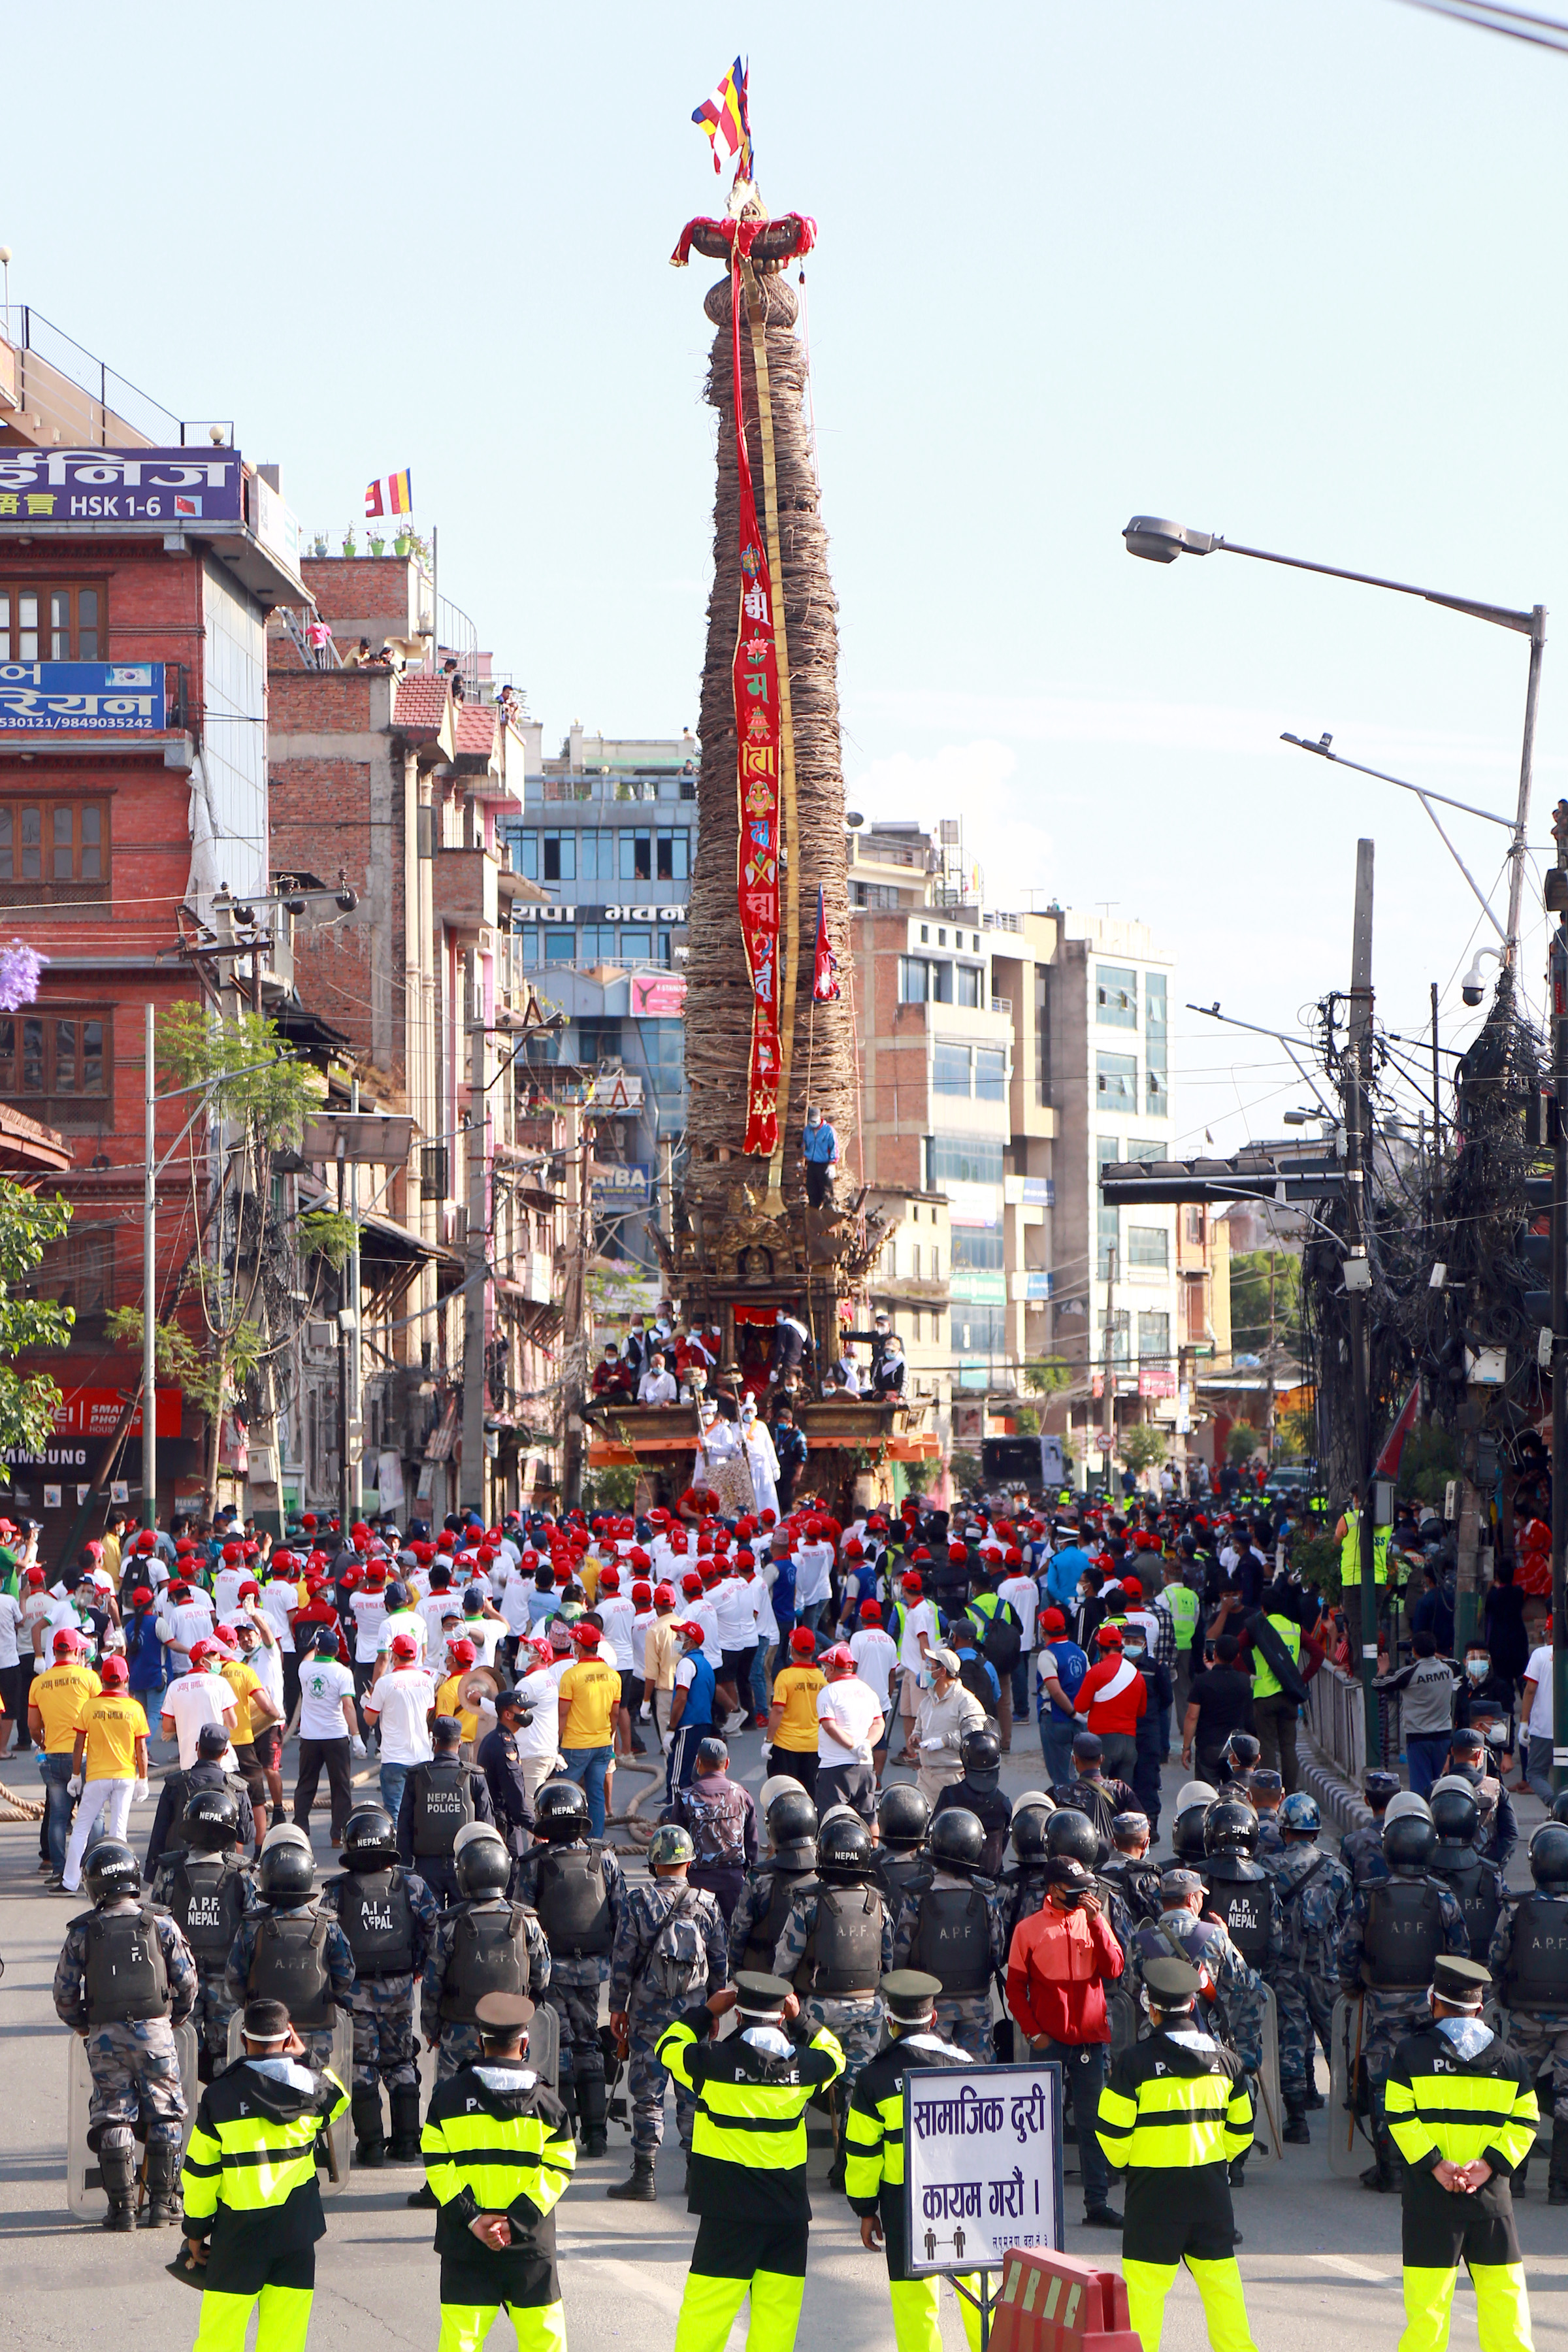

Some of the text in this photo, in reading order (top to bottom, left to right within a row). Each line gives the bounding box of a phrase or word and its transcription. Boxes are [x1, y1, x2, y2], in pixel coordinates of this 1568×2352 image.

[71, 496, 119, 516] HSK
[125, 496, 161, 516] 1-6
[0, 1448, 86, 1465] AMSUNG
[1416, 1670, 1450, 1684] ARMY
[427, 1793, 460, 1803] NEPAL
[427, 1804, 461, 1813] POLICE
[551, 1806, 576, 1816] NEPAL
[199, 1812, 223, 1822] NEPAL
[357, 1837, 381, 1847] NEPAL
[835, 1851, 859, 1861] NEPAL
[101, 1862, 127, 1876] NEPAL
[188, 1912, 220, 1926] NEPAL
[1228, 1913, 1257, 1929] NEPAL
[914, 2083, 1045, 2144] सामाजिक दुरी
[923, 2182, 982, 2220] कायम
